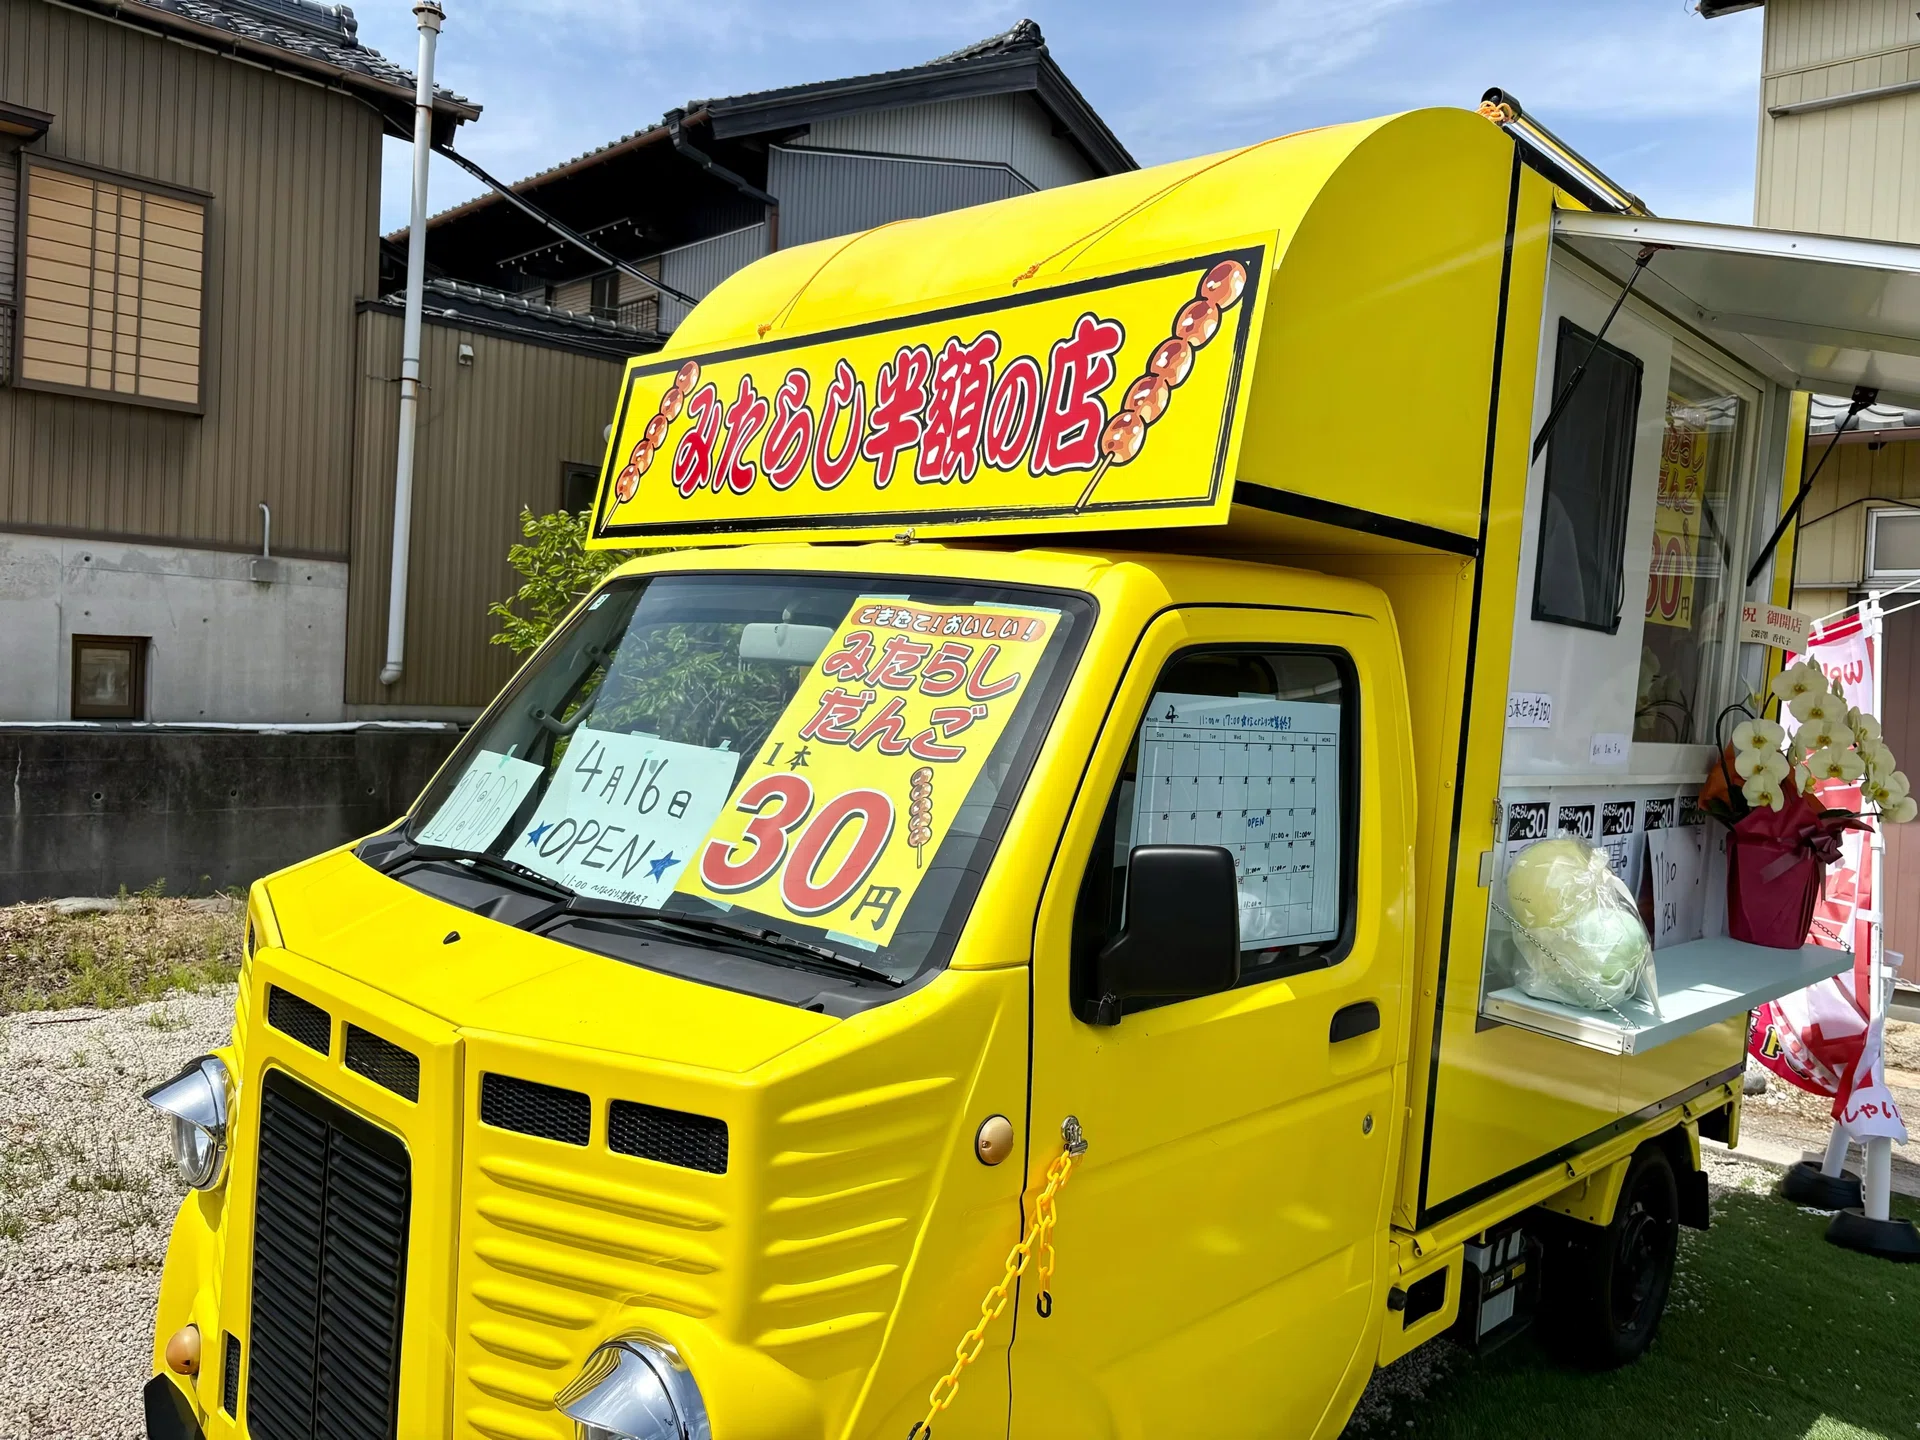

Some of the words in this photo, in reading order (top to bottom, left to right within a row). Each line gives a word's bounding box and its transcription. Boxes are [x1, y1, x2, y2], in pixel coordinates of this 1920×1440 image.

[672, 312, 1125, 497] みたらし半額の店
[1767, 610, 1802, 634] 御開店
[822, 631, 1020, 700] みたらし
[800, 687, 988, 762] だんご
[1165, 704, 1179, 723] 4
[575, 740, 692, 819] 4月16日
[1247, 816, 1265, 828] OPEN
[1510, 805, 1528, 819] みたらし
[1560, 807, 1576, 820] みたらし
[1603, 804, 1618, 816] みたらし
[539, 818, 655, 879] OPEN
